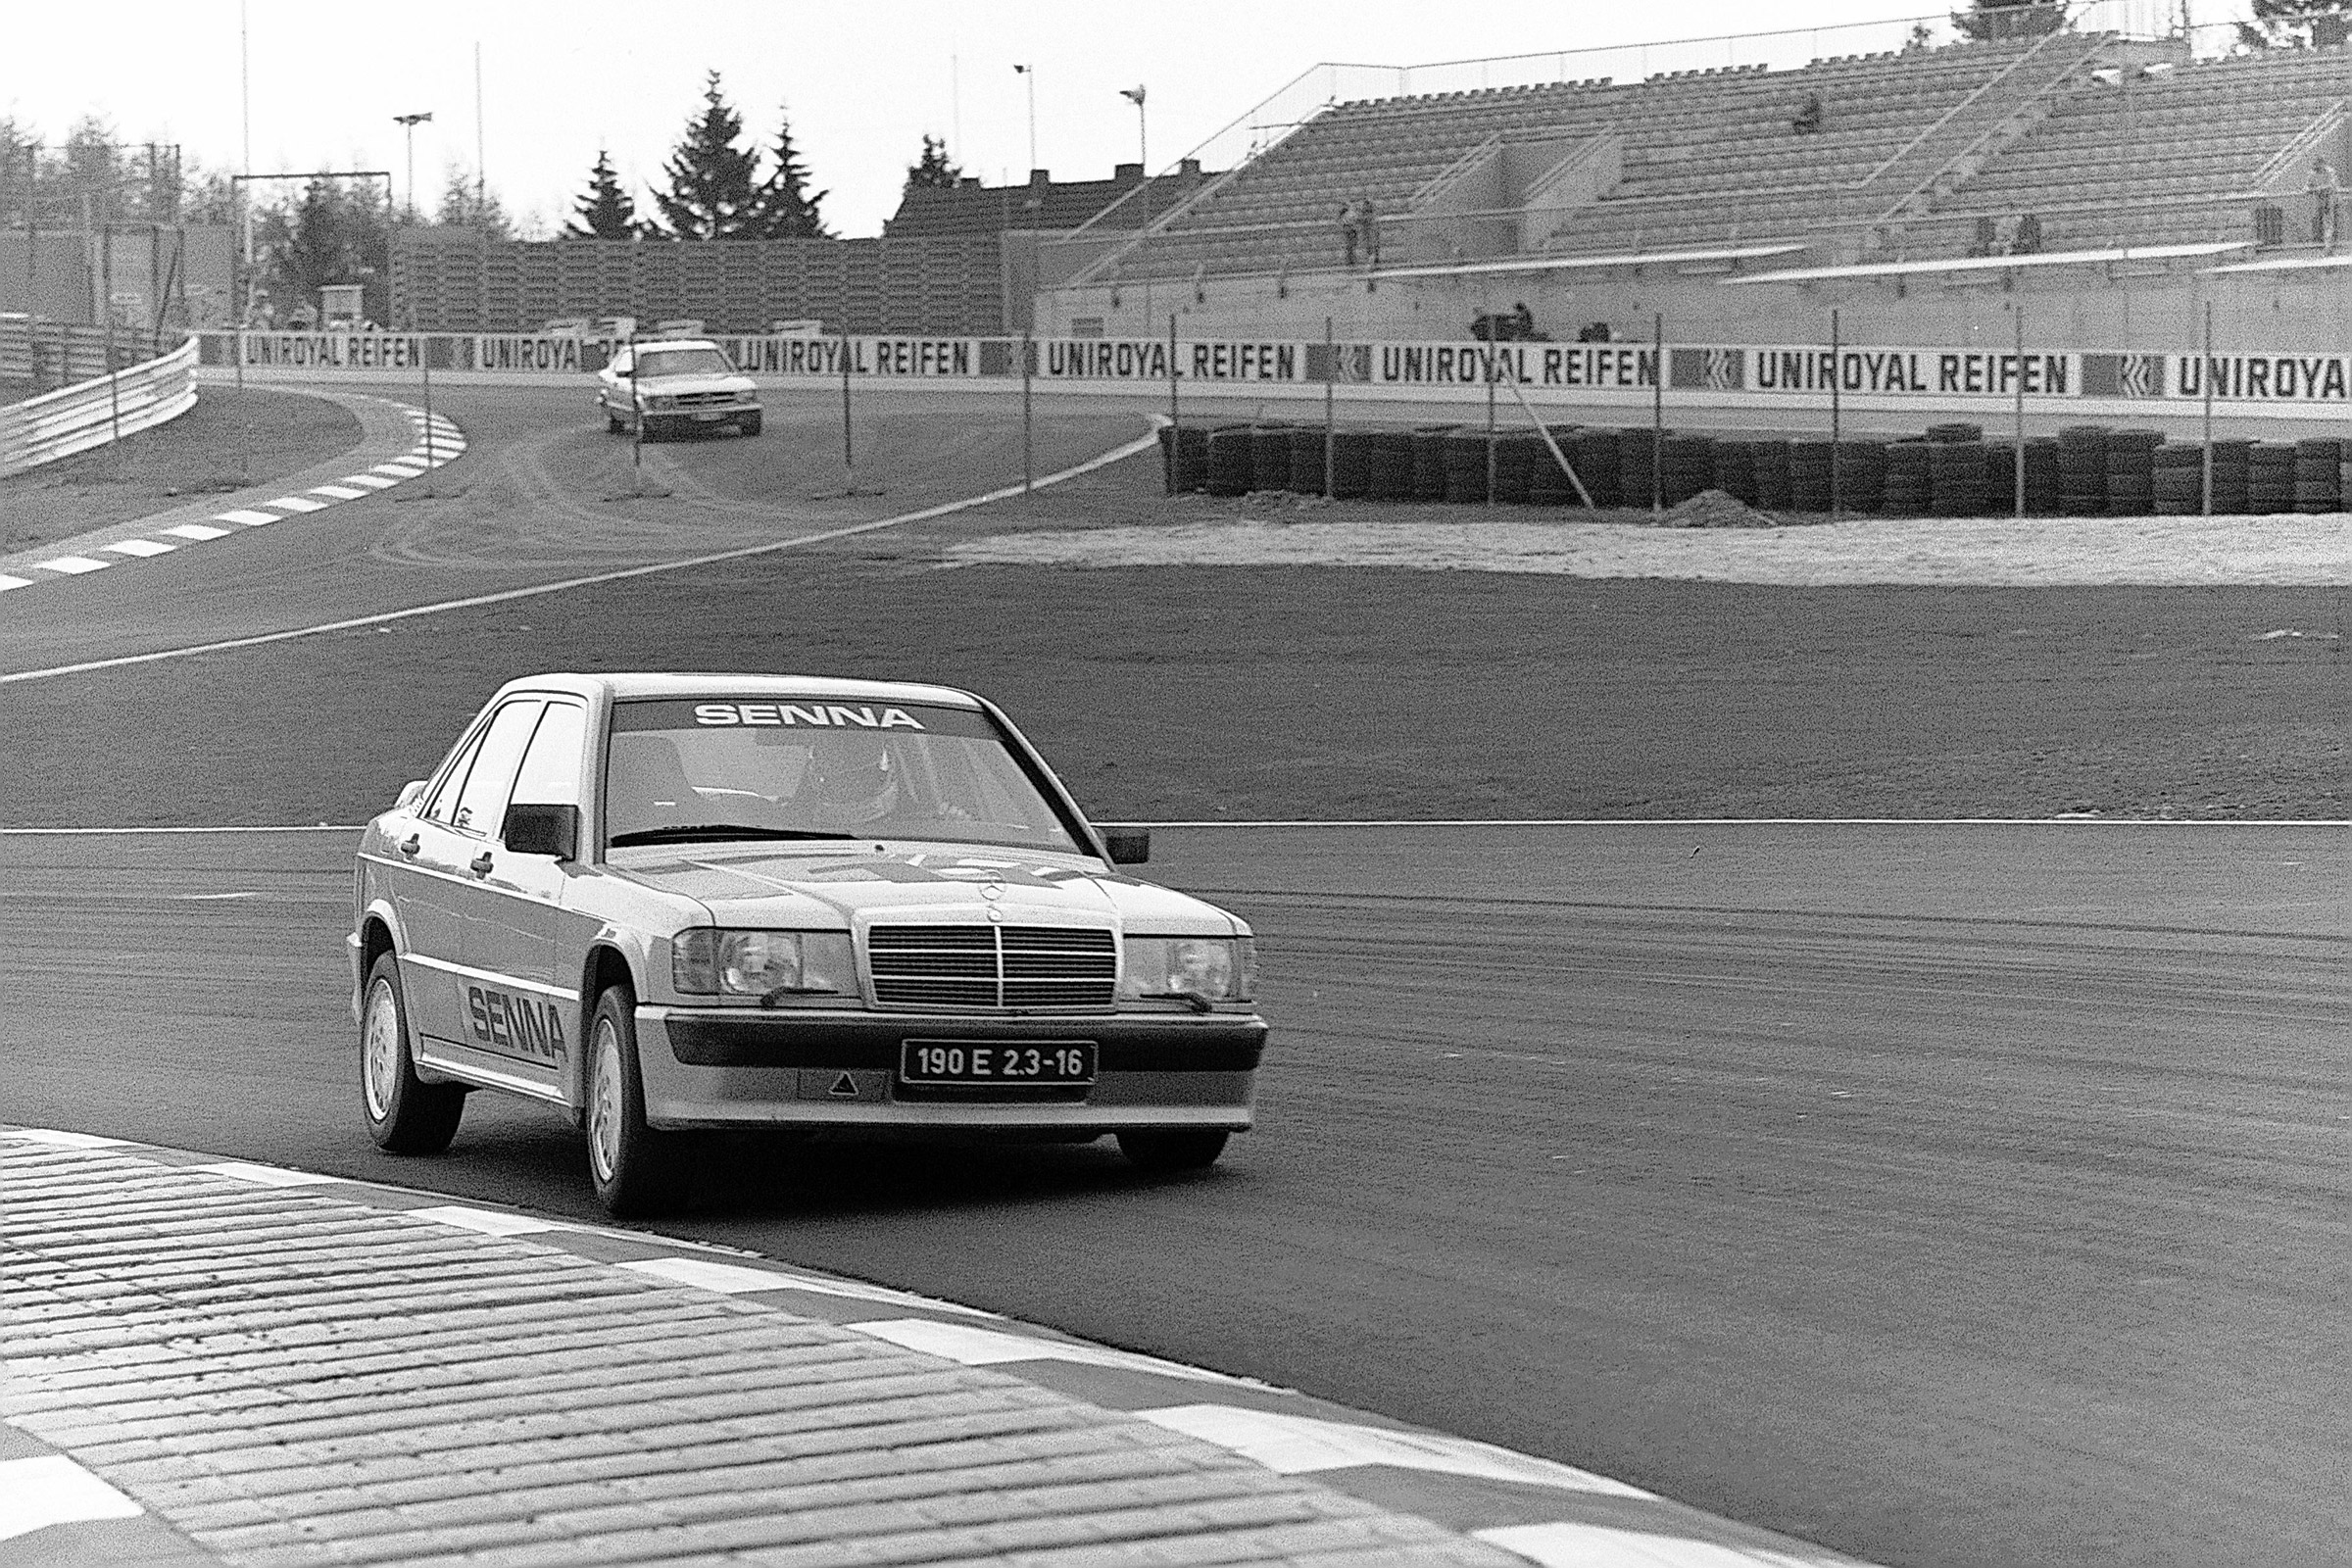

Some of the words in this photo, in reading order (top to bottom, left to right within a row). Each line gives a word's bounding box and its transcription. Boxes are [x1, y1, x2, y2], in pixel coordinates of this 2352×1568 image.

[246, 336, 343, 367] UNIROYAL
[349, 337, 420, 368] REIFEN
[482, 339, 585, 369] UNIROYA
[748, 341, 869, 372] UNIROYAL
[878, 341, 968, 373] REIFEN
[1049, 342, 1184, 377] UNIROYAL
[1193, 344, 1296, 379] REIFEN
[1383, 346, 1534, 384] UNIROYAL
[1544, 348, 1659, 385] REIFEN
[1758, 352, 1928, 392] UNIROYAL
[1939, 354, 2068, 393] REIFEN
[2180, 357, 2352, 398] UNIROYA
[694, 704, 926, 730] SENNA
[468, 986, 569, 1061] SENNA
[917, 1048, 964, 1075] 190
[972, 1049, 994, 1076] E
[1003, 1049, 1083, 1076] 2.3-16
